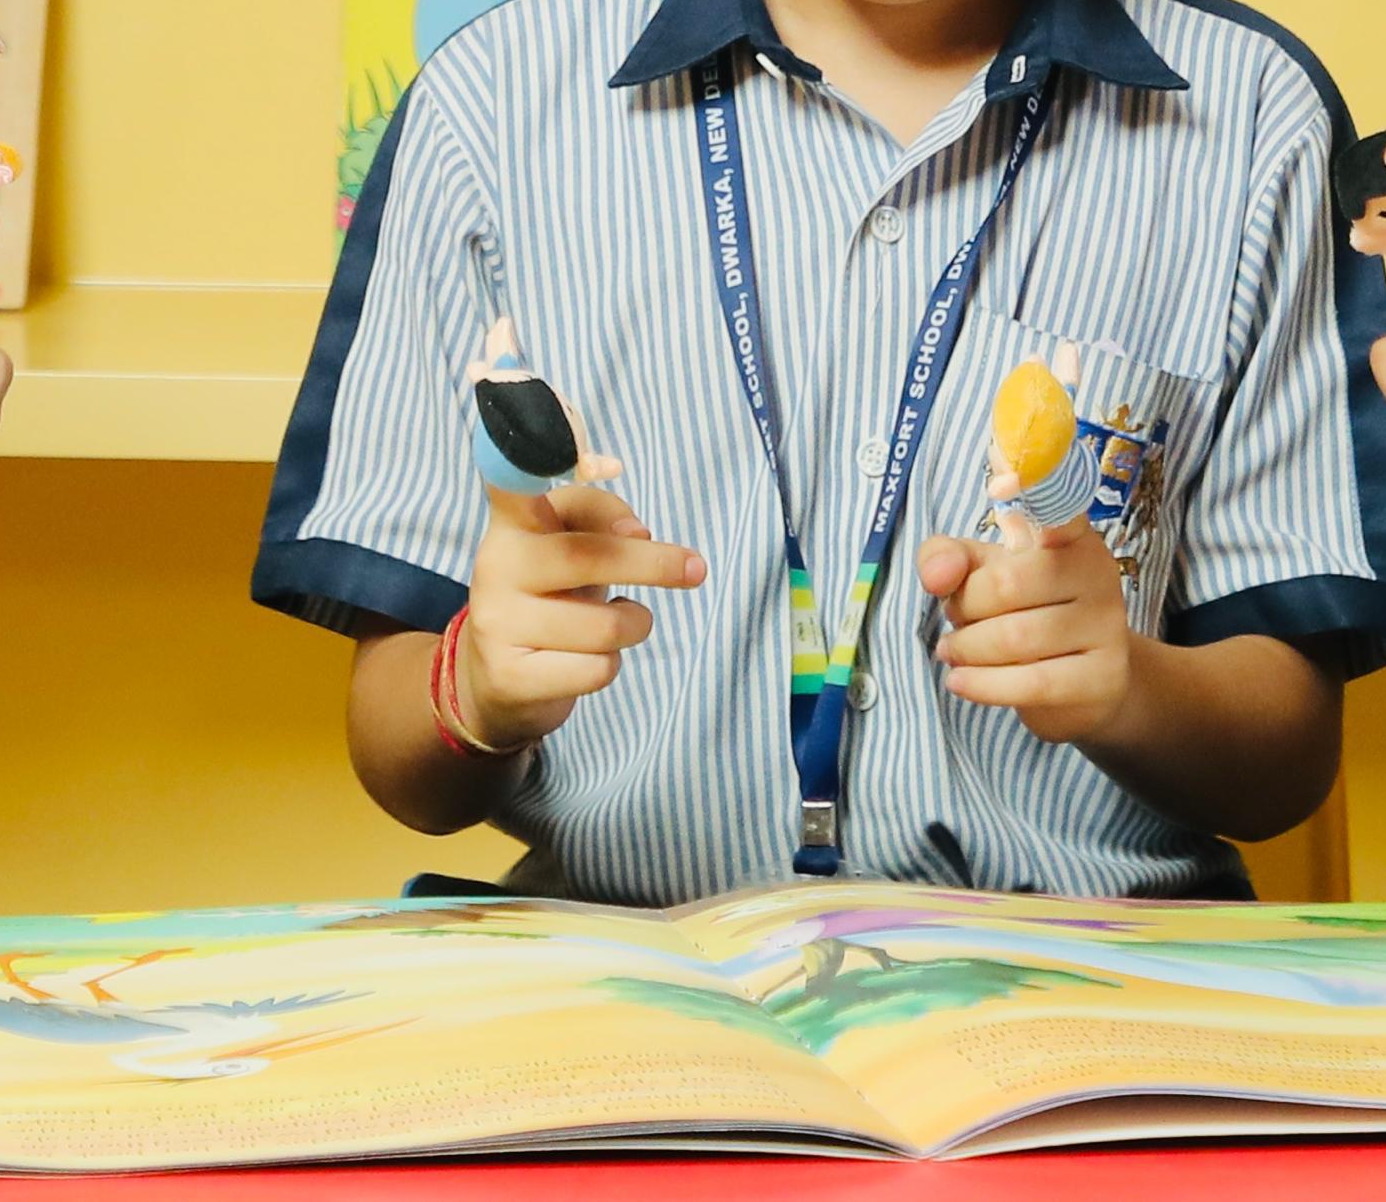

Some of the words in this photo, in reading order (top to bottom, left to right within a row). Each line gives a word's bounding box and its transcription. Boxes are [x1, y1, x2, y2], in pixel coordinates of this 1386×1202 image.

[705, 108, 729, 163] NEW
[714, 168, 743, 288] DWARKA,
[733, 293, 763, 409] SCHOOL,
[874, 405, 919, 533] MAXFORT
[909, 287, 957, 400] SCHOOL,
